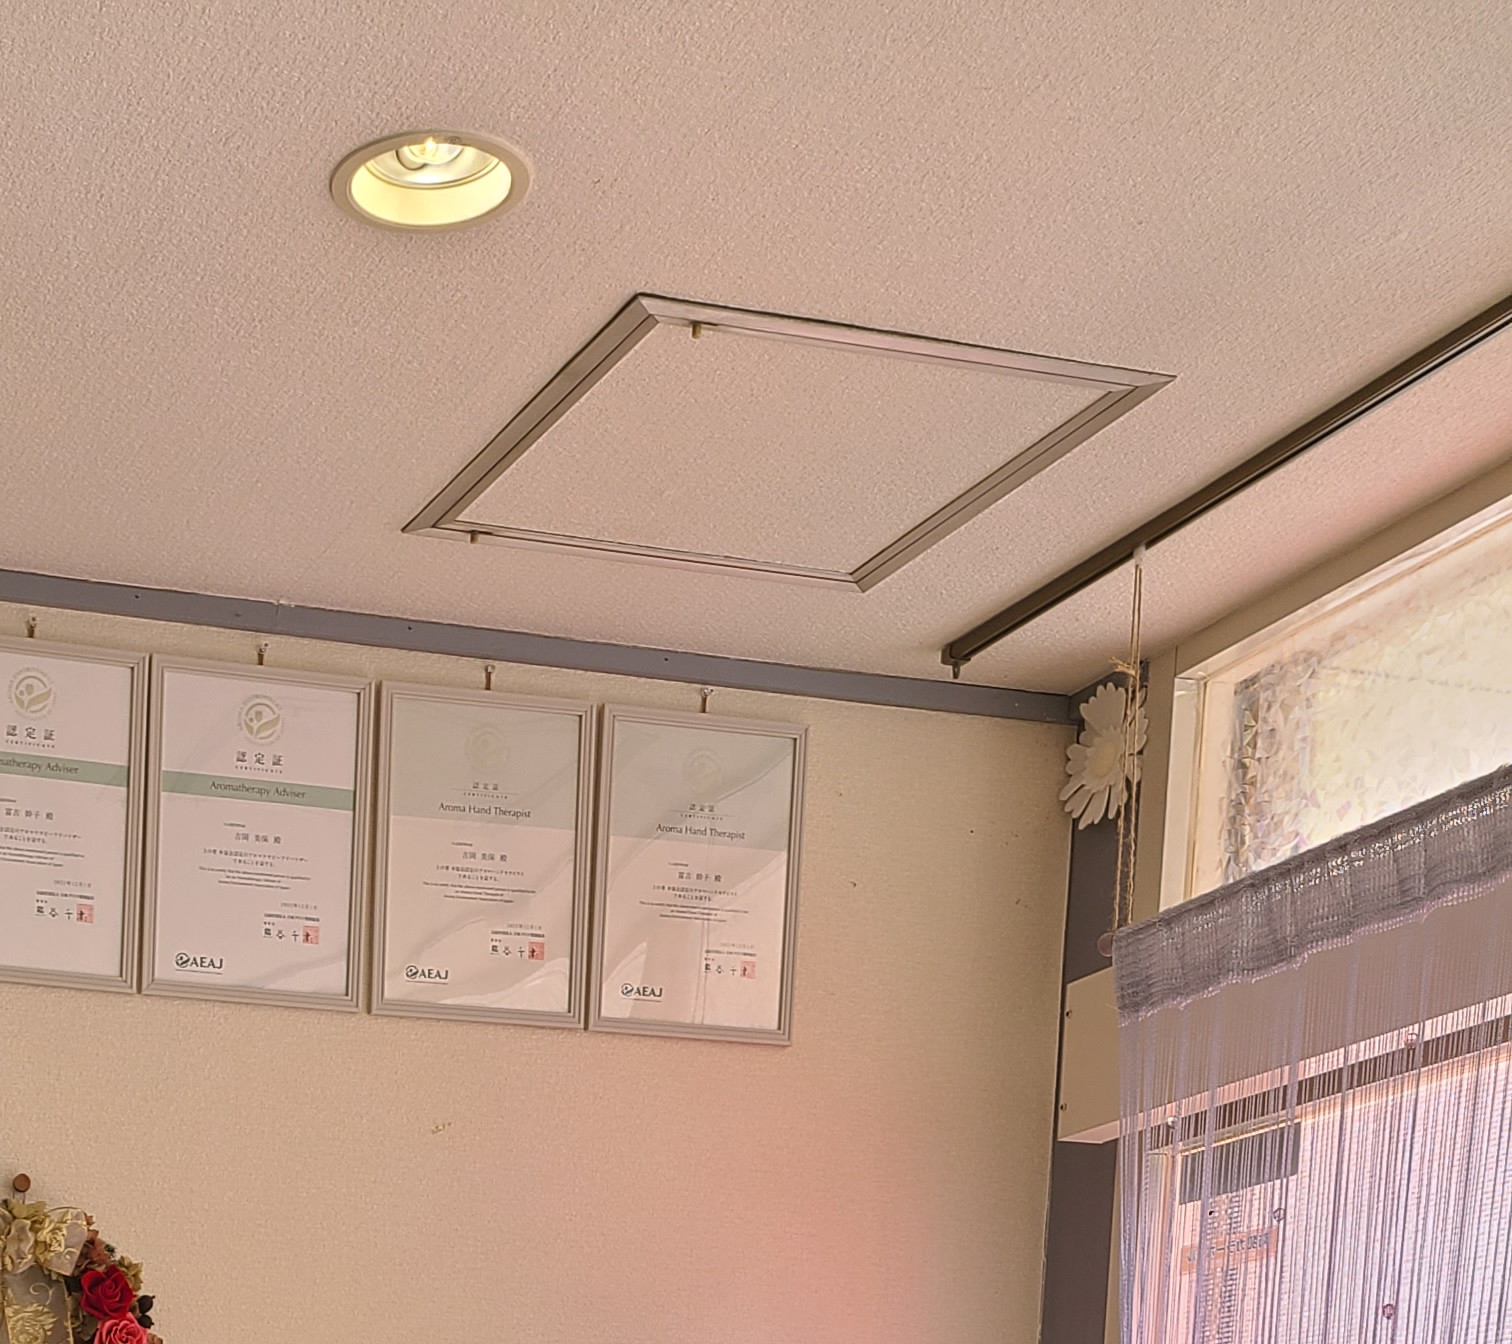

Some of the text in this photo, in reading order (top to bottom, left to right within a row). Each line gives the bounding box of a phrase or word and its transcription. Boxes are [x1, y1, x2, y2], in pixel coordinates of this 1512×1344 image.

[5, 725, 55, 741] 認定証
[236, 751, 283, 766] 認定証
[46, 762, 79, 774] Adviser
[210, 781, 306, 799] Aromatherapy Adviser
[472, 782, 499, 791] 認定証
[439, 802, 531, 819] Aroma Hand Therapist
[689, 803, 715, 812] 認定証
[656, 824, 745, 841] Aroma Hand Therapist
[190, 956, 223, 969] AEAJ
[419, 967, 449, 980] AEAJ
[635, 986, 663, 998] AEAJ
